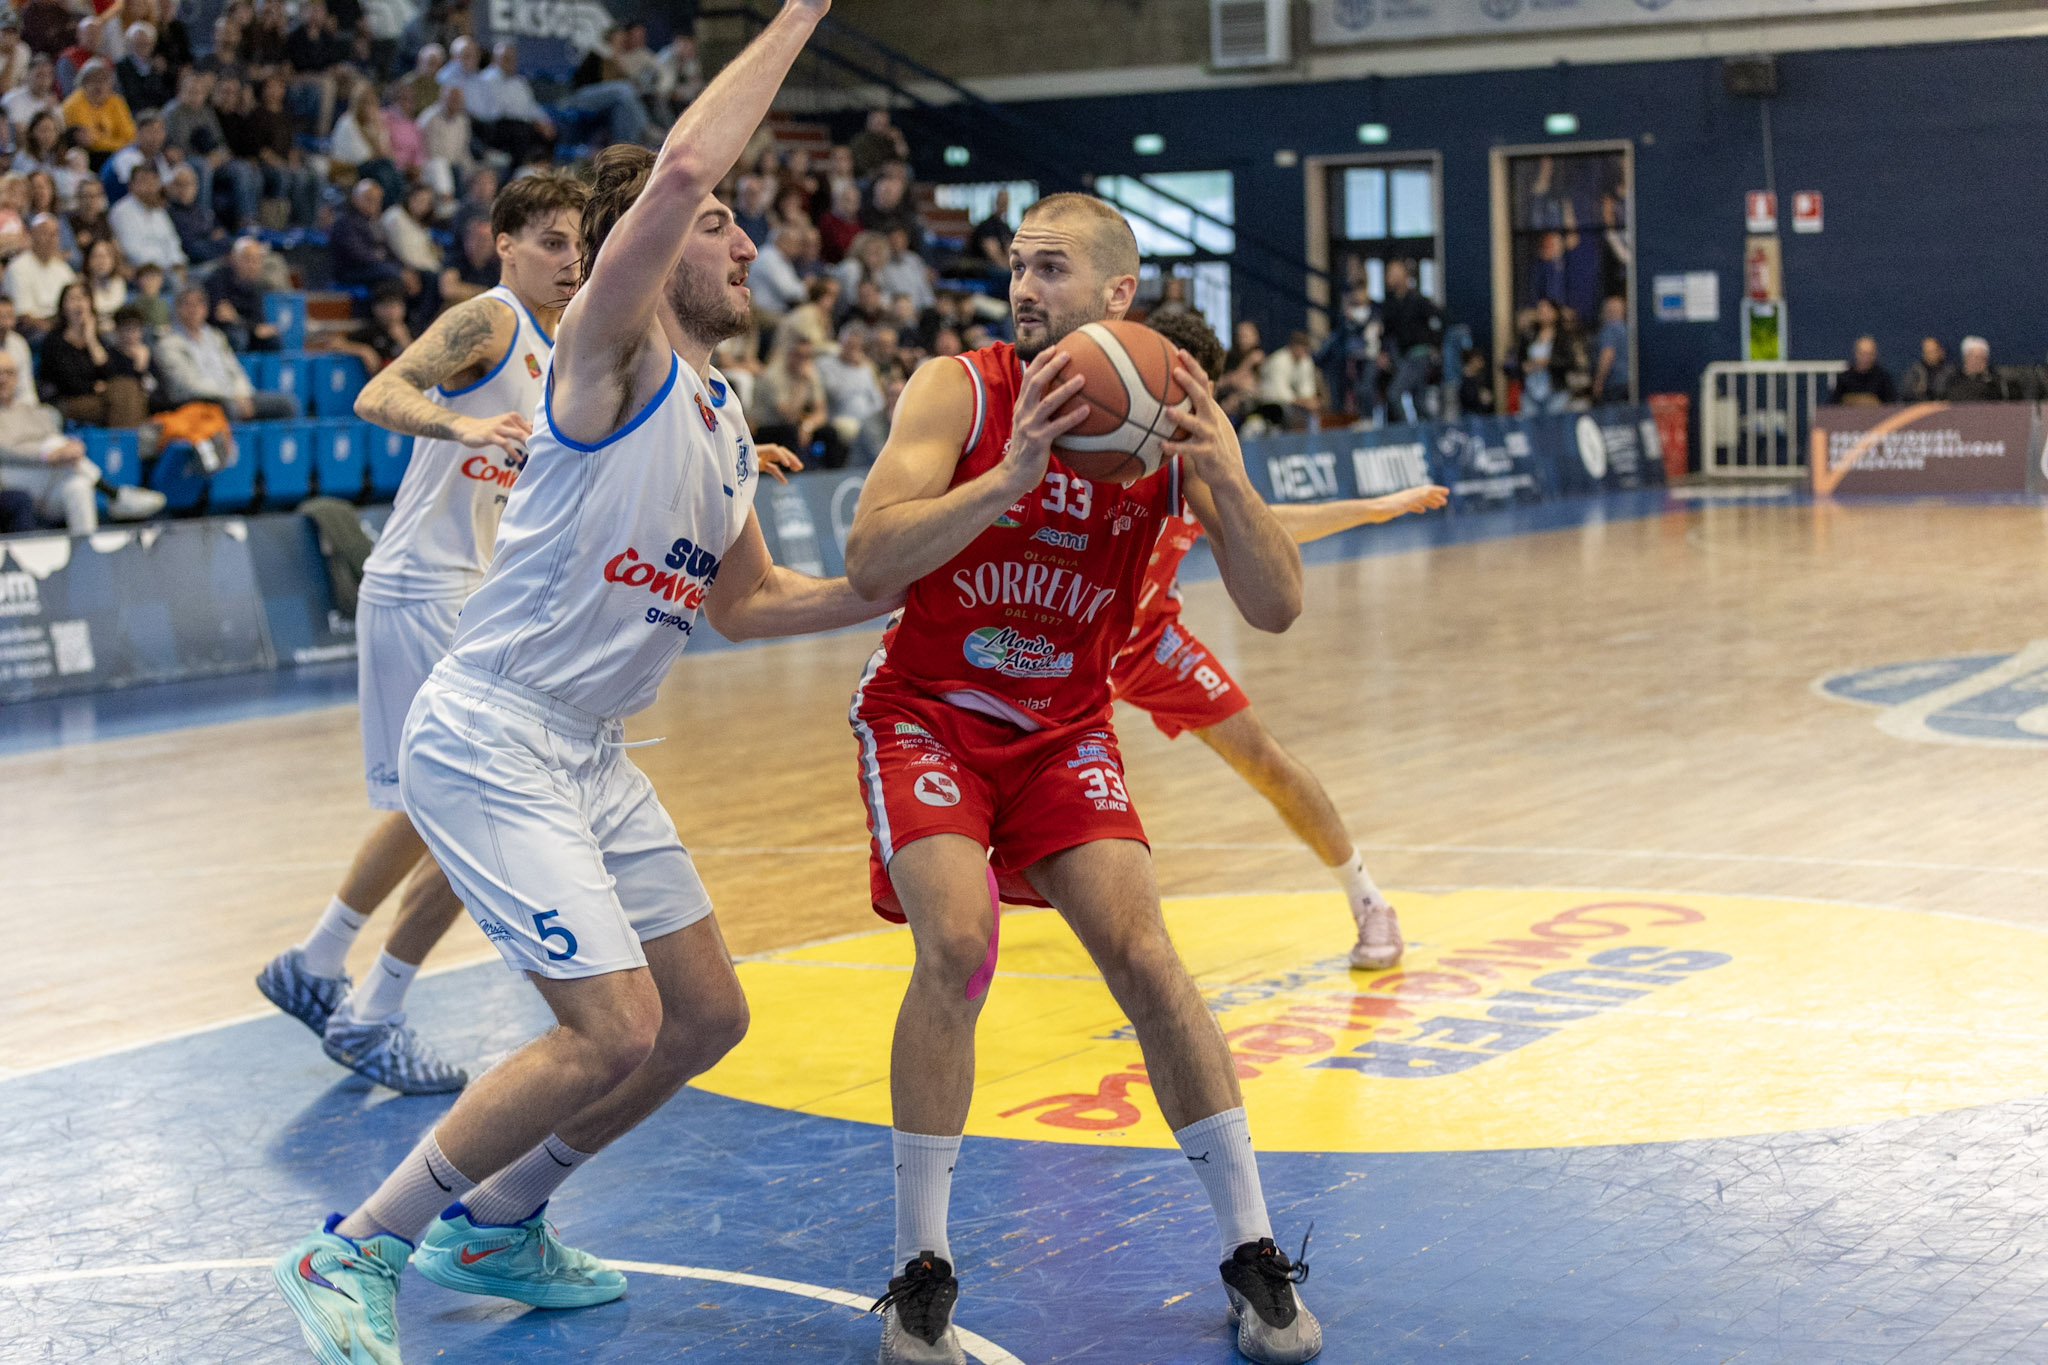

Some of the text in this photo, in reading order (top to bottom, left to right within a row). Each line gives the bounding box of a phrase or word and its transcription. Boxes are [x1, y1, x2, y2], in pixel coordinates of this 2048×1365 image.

[1268, 452, 1338, 501] NEXT
[1041, 472, 1093, 520] 33
[1024, 551, 1079, 567] OLEARIA
[1005, 607, 1064, 626] DAL 1977
[984, 627, 1055, 656] Mondo
[1194, 665, 1221, 690] 8
[896, 738, 923, 746] Marco
[921, 753, 941, 761] CG
[1078, 767, 1129, 803] 33
[532, 909, 578, 961] 5
[1304, 946, 1734, 1079] SUPER
